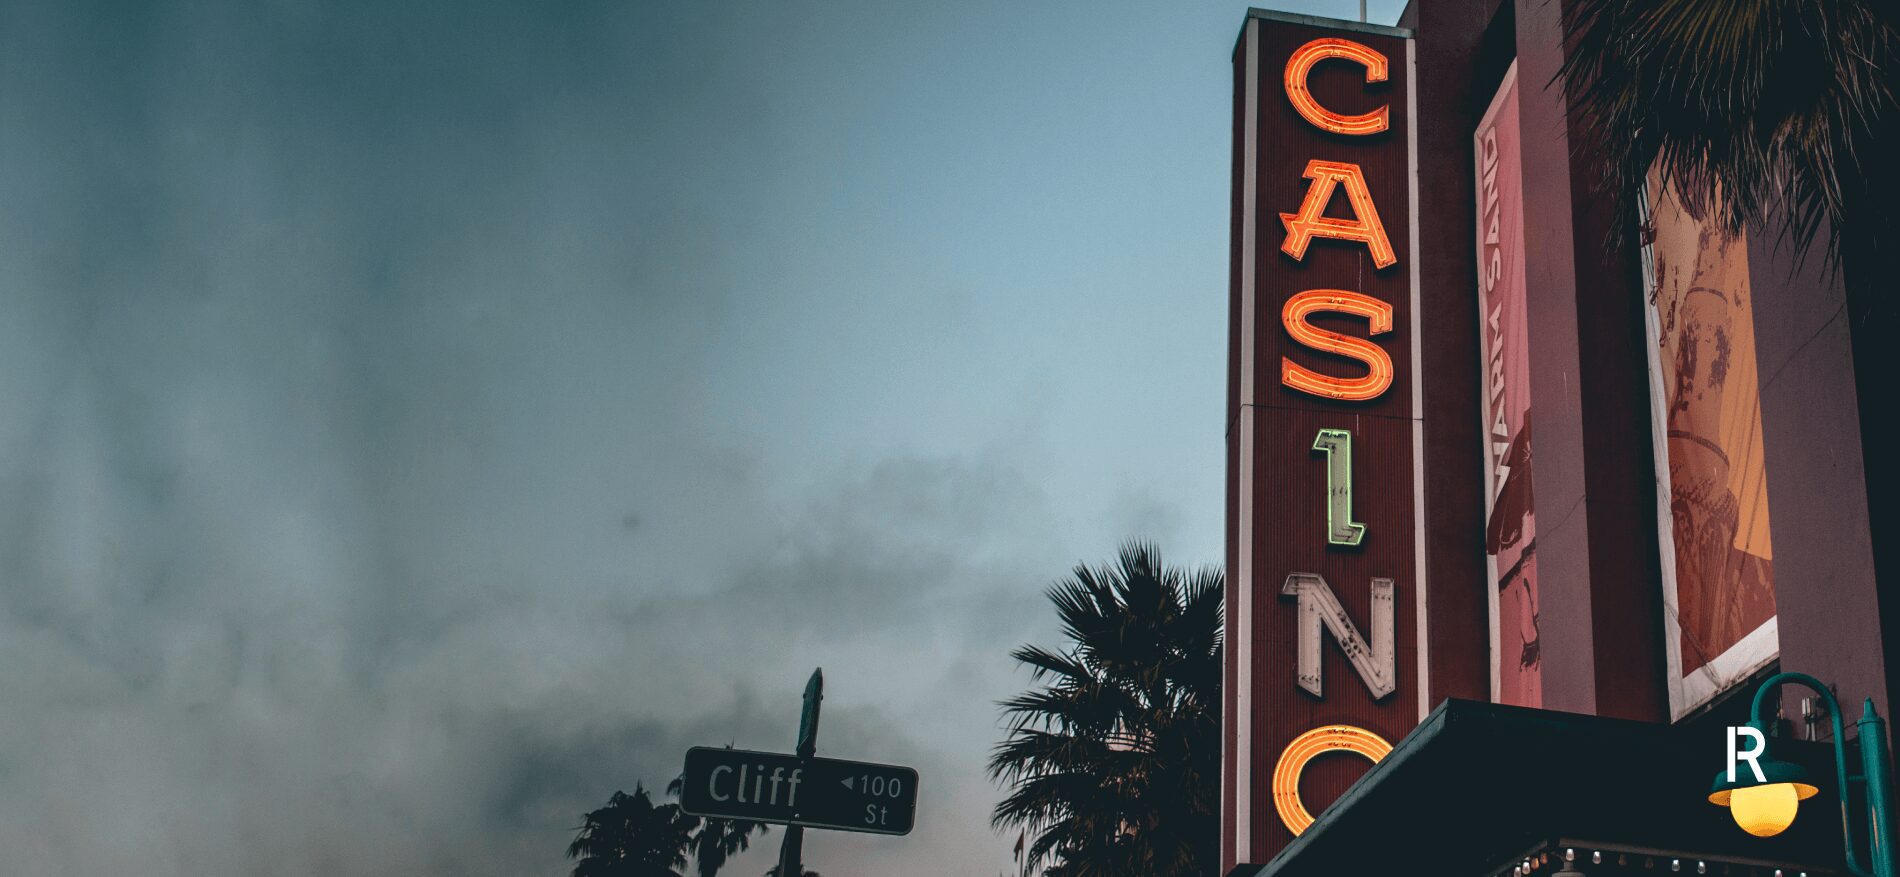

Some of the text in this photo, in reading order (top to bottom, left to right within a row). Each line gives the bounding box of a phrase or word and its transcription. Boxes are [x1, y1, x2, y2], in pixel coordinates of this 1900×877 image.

[1483, 126, 1511, 505] WARM SAND
[1272, 37, 1397, 837] CASINO
[709, 764, 901, 806] Cliff 100
[865, 803, 888, 825] St
